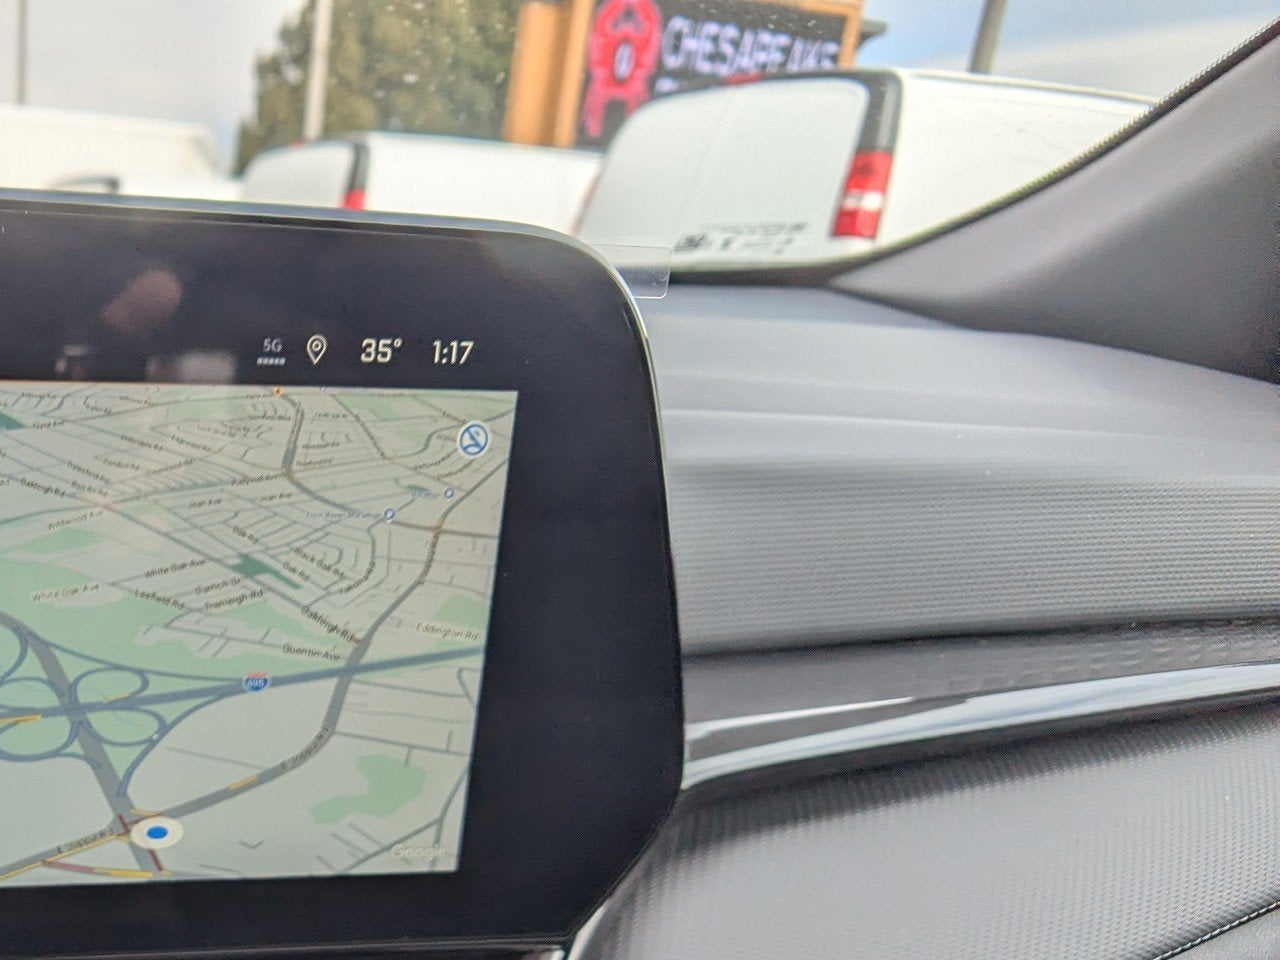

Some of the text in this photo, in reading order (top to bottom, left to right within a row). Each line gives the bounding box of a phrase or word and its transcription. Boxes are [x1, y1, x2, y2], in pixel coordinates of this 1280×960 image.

[263, 338, 282, 352] 5G
[360, 337, 403, 363] 35°
[432, 339, 474, 364] 1:17
[189, 558, 206, 568] Ave
[322, 652, 341, 662] Ave
[391, 844, 446, 862] Google
